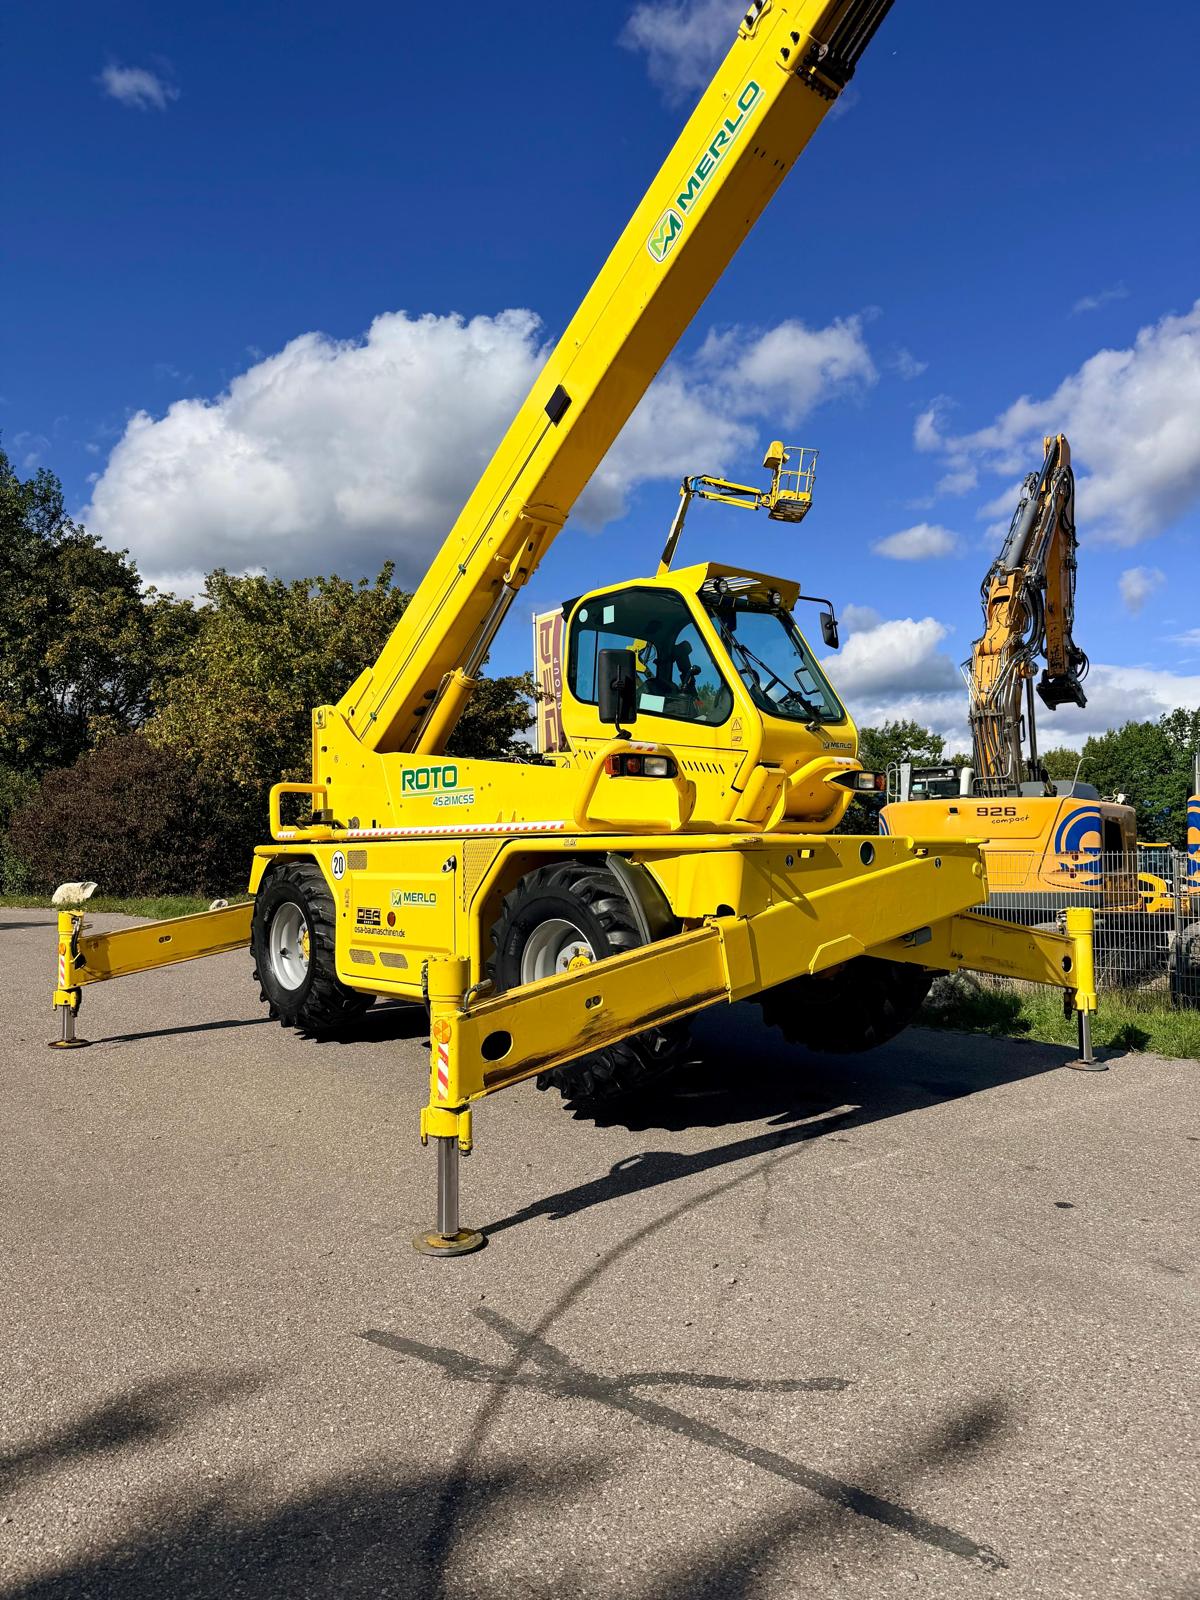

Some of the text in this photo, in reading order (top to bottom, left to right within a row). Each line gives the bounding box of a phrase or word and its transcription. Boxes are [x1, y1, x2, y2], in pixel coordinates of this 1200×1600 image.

[676, 80, 760, 211] MERLO
[402, 765, 458, 791] ROTO
[976, 806, 1016, 817] 926
[991, 815, 1029, 824] compact
[333, 856, 344, 874] 20
[403, 892, 437, 903] MERLO
